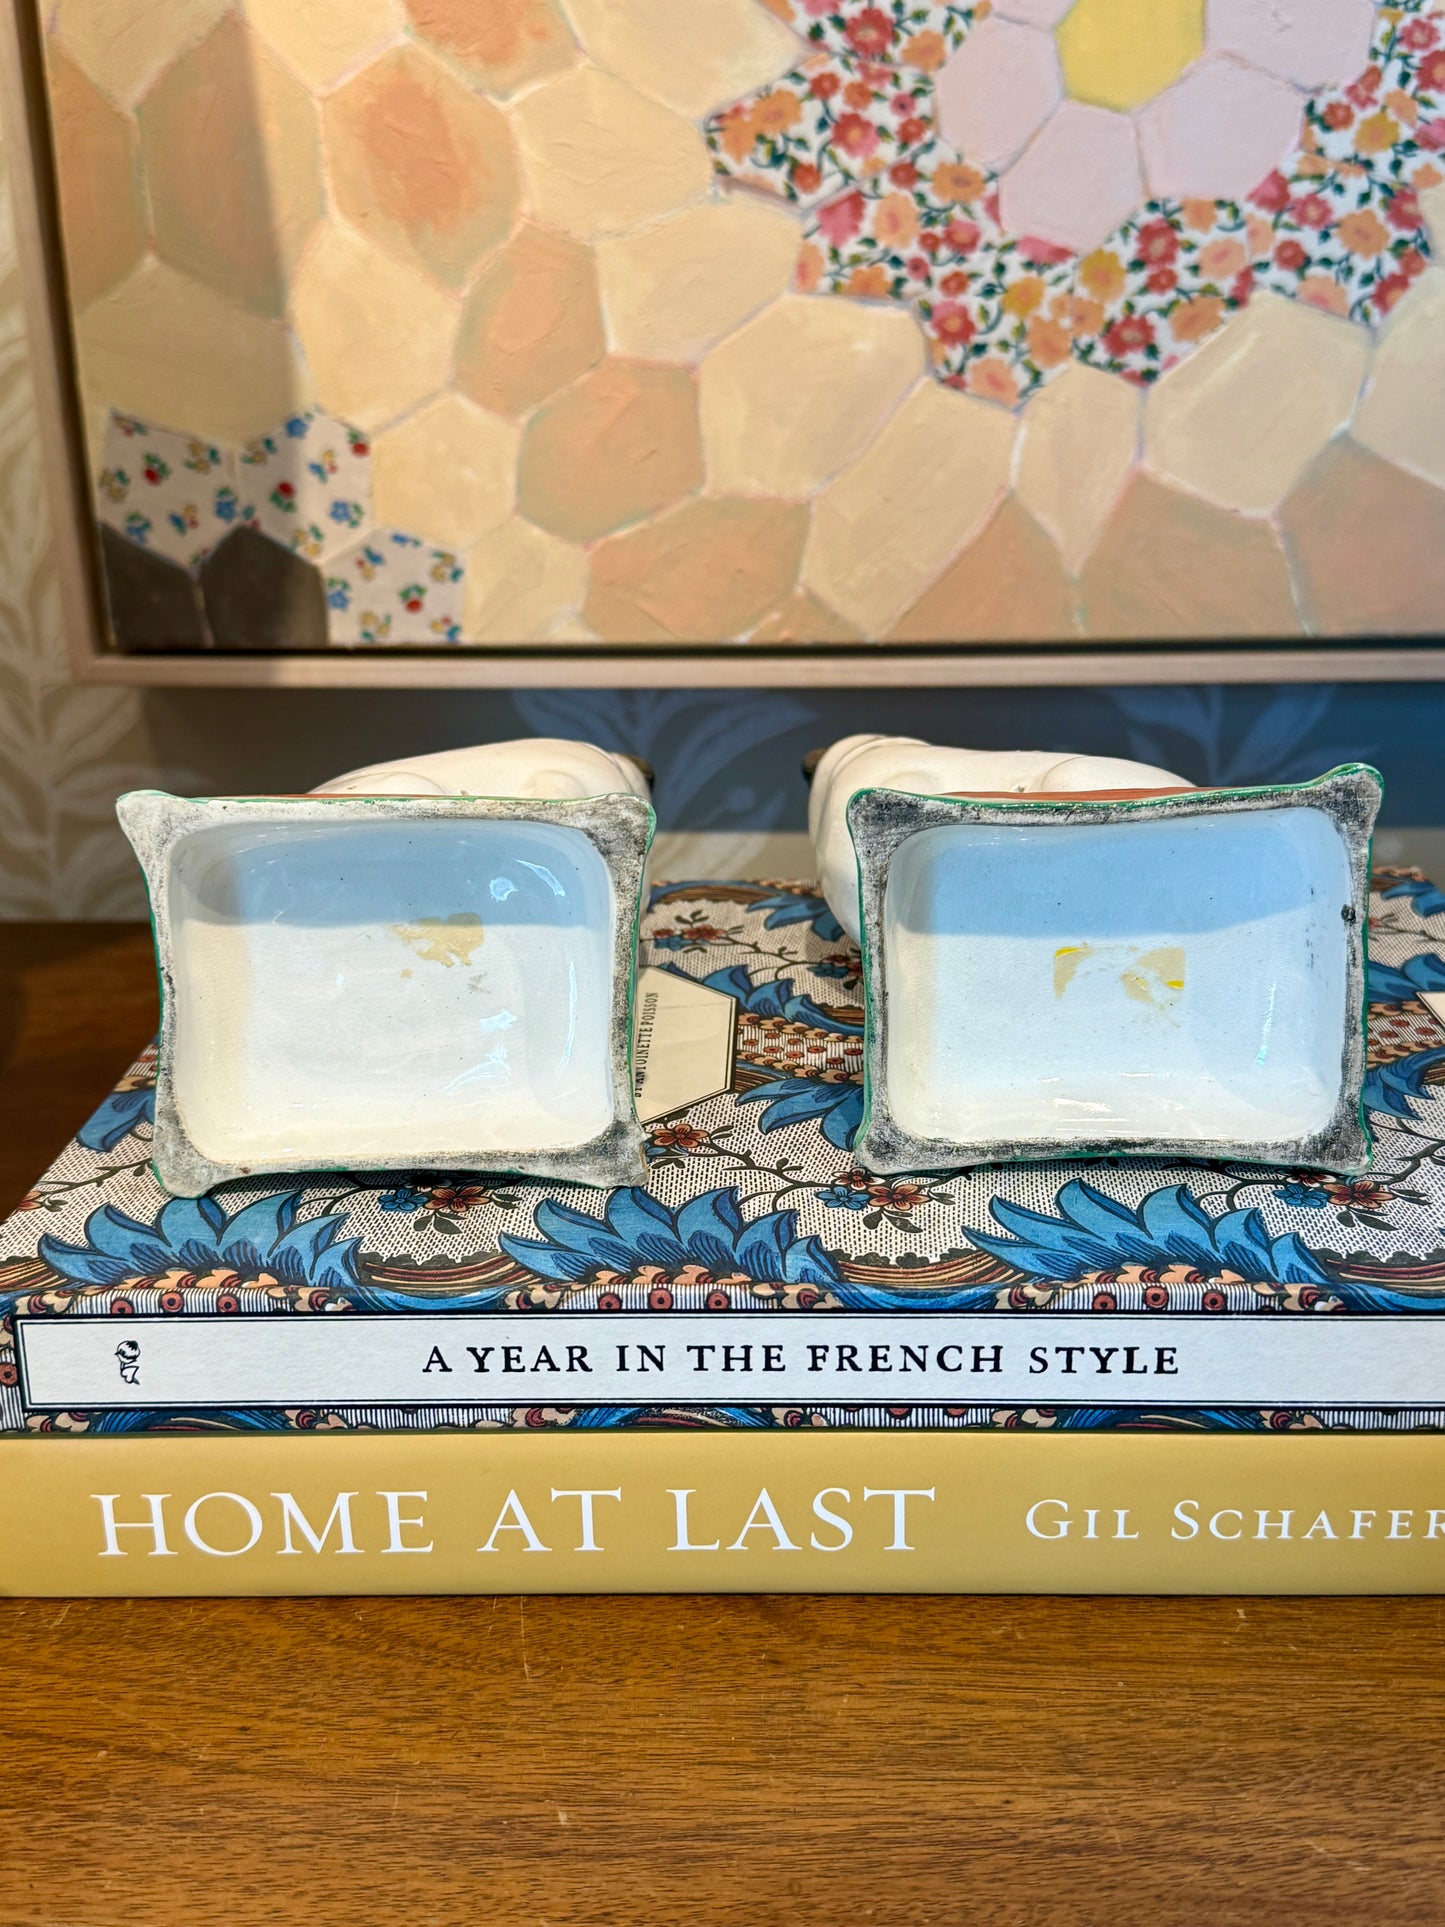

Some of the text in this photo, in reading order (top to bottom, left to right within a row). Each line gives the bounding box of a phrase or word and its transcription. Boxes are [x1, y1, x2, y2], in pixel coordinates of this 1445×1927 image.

[641, 992, 658, 1025] POISSON
[422, 1343, 1179, 1374] A YEAR IN THE FRENCH STYLE
[91, 1486, 936, 1556] HOME AT LAST
